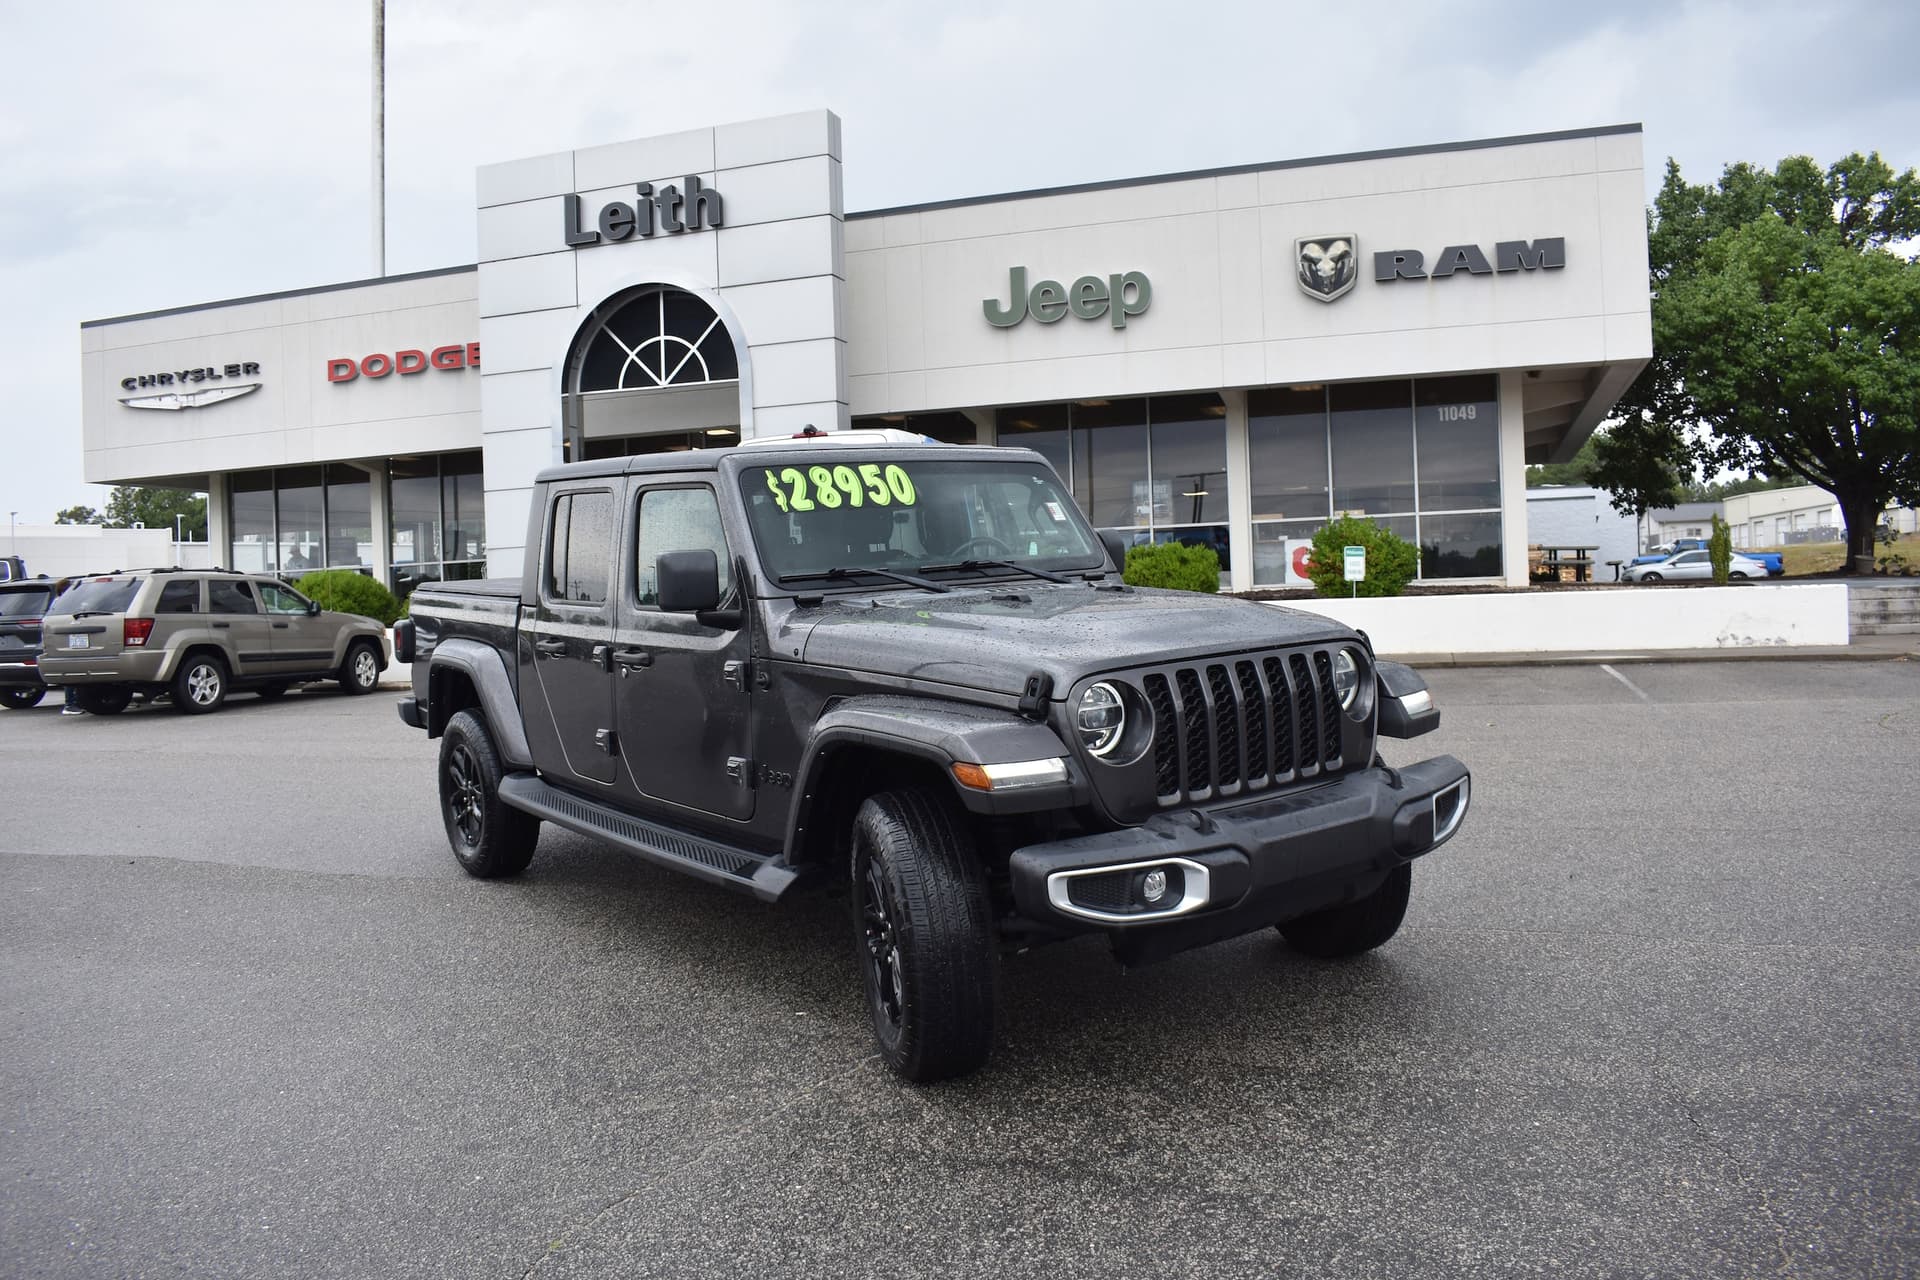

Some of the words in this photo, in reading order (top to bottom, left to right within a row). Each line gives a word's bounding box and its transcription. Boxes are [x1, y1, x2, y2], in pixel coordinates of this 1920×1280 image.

[564, 175, 724, 247] Leith
[1373, 236, 1566, 281] RAM
[982, 265, 1152, 329] Jeep
[120, 361, 261, 390] CHRYSLER
[1438, 405, 1476, 421] 11049
[765, 463, 916, 512] $28950
